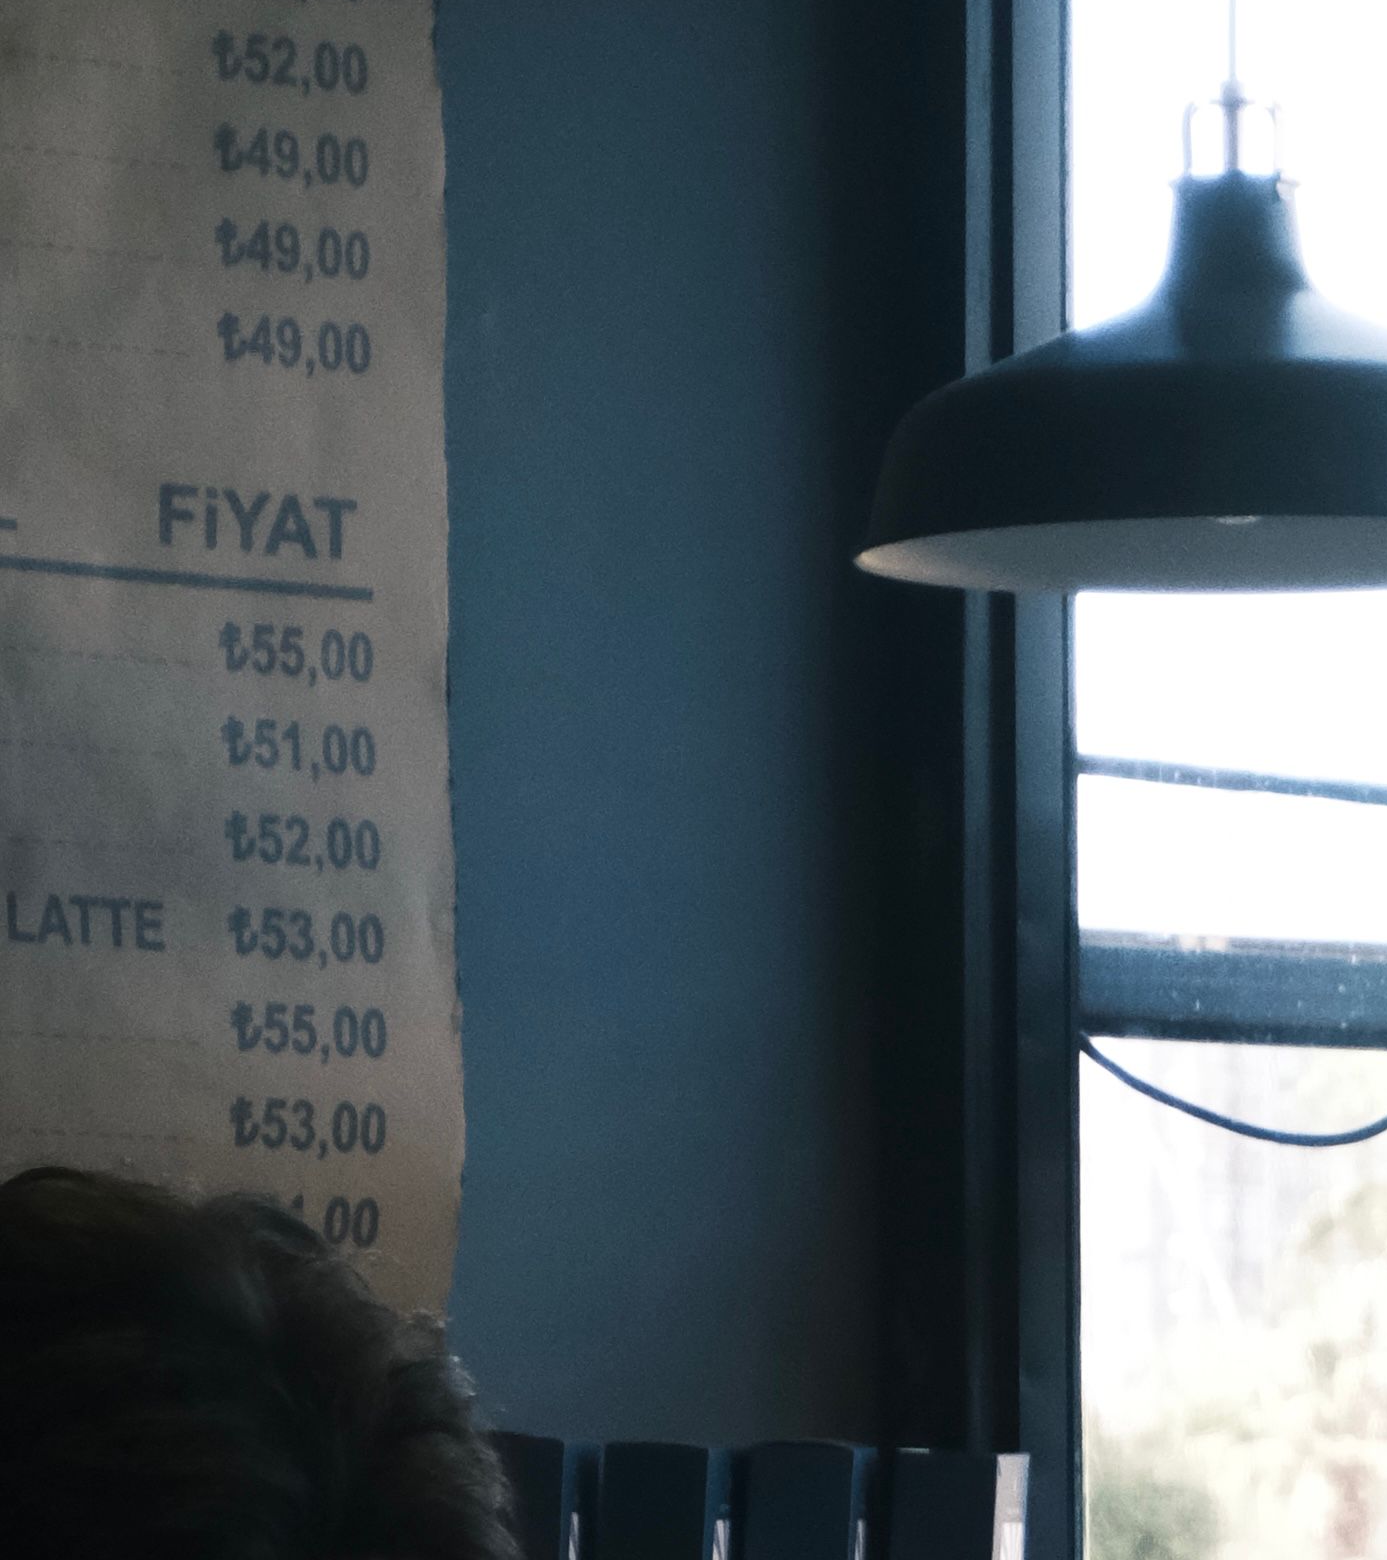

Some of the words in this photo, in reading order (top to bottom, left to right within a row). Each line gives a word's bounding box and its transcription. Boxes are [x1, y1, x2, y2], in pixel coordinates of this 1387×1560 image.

[211, 30, 367, 95] ₺52,00
[211, 122, 368, 187] ₺49,00
[215, 217, 369, 283] ₺49,00
[217, 310, 371, 377] ₺49,00
[219, 622, 373, 687] ₺55,00
[221, 716, 375, 782] ₺51,00
[224, 811, 380, 871] ₺52,00
[6, 889, 166, 952] LATTE
[226, 905, 384, 968] ₺53,00
[231, 1001, 386, 1064] ₺55,00
[229, 1096, 385, 1160] ₺53,00
